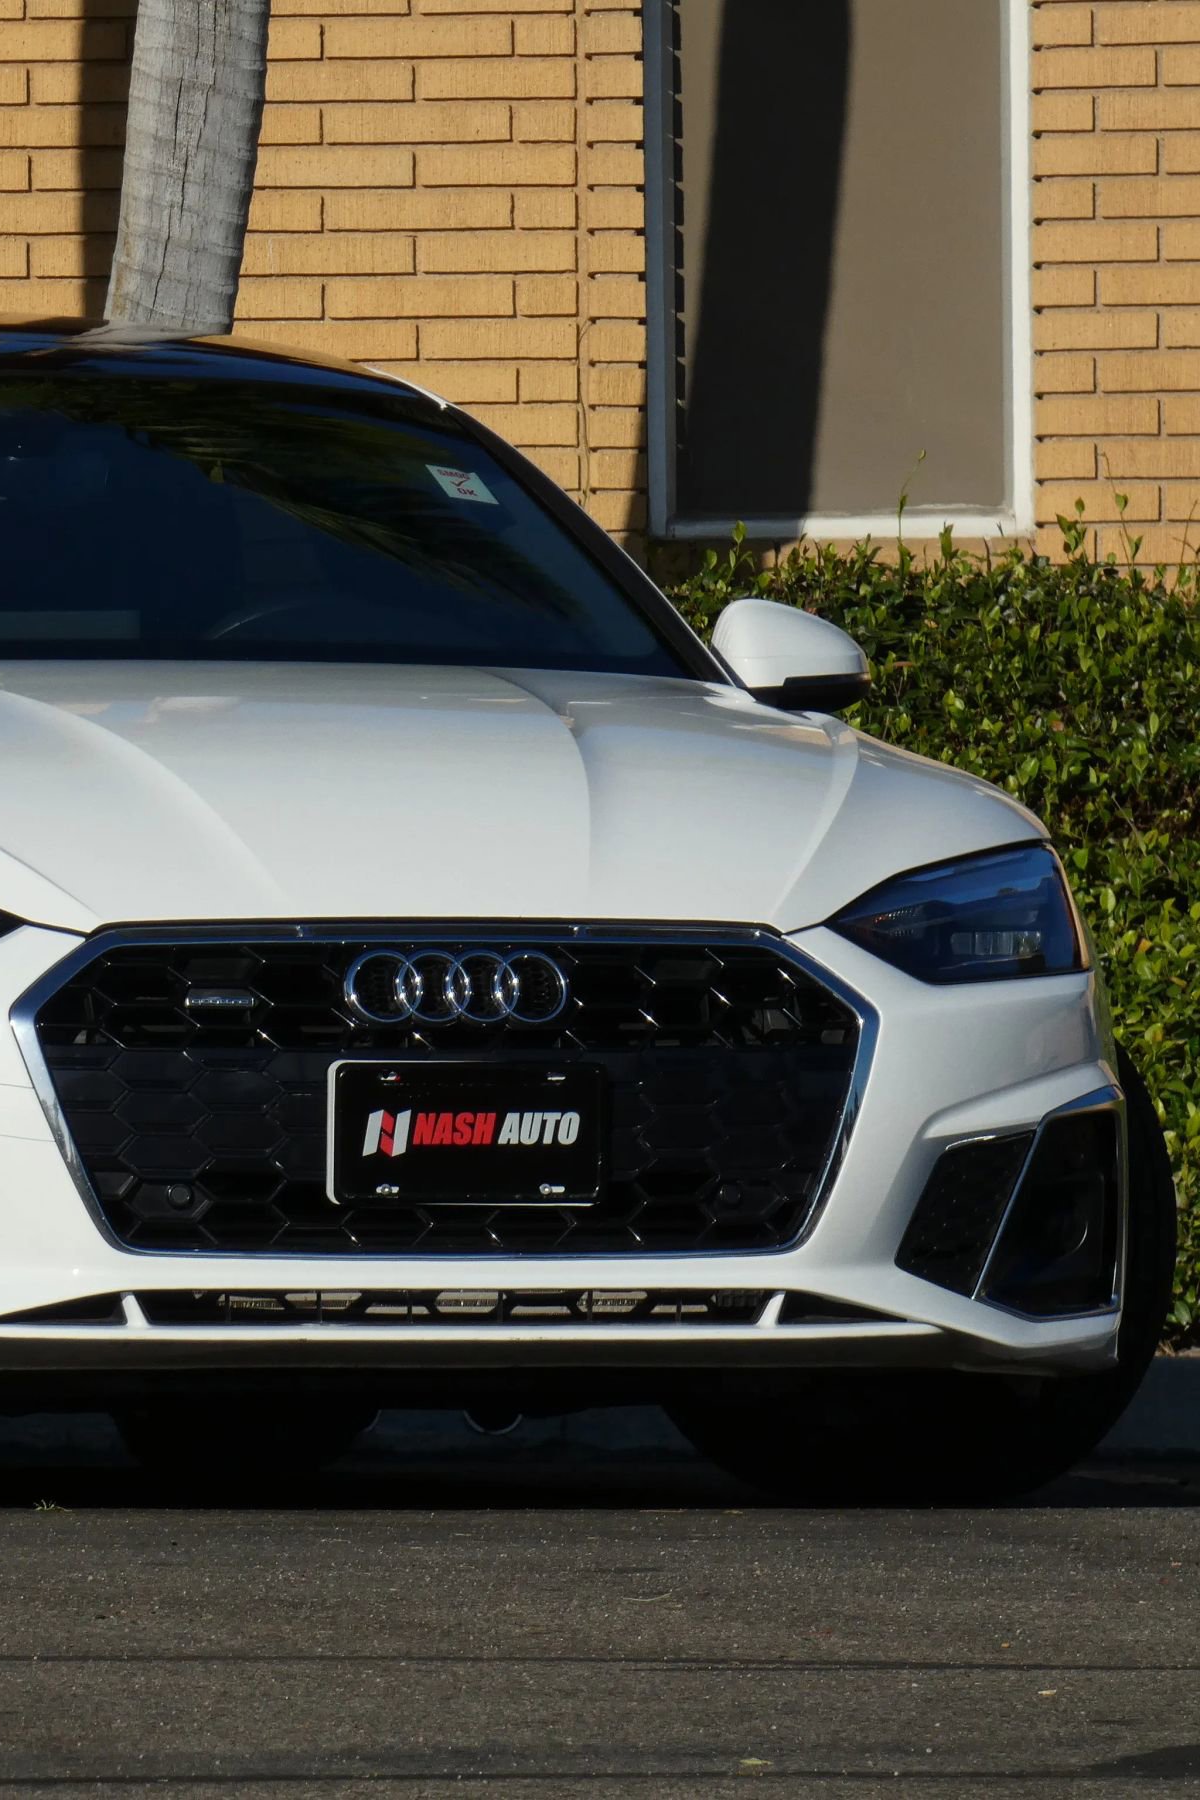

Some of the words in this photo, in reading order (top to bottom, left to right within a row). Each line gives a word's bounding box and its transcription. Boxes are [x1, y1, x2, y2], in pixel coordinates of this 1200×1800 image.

[456, 487, 478, 497] OK
[413, 1112, 497, 1145] NASH
[498, 1111, 581, 1145] AUTO
